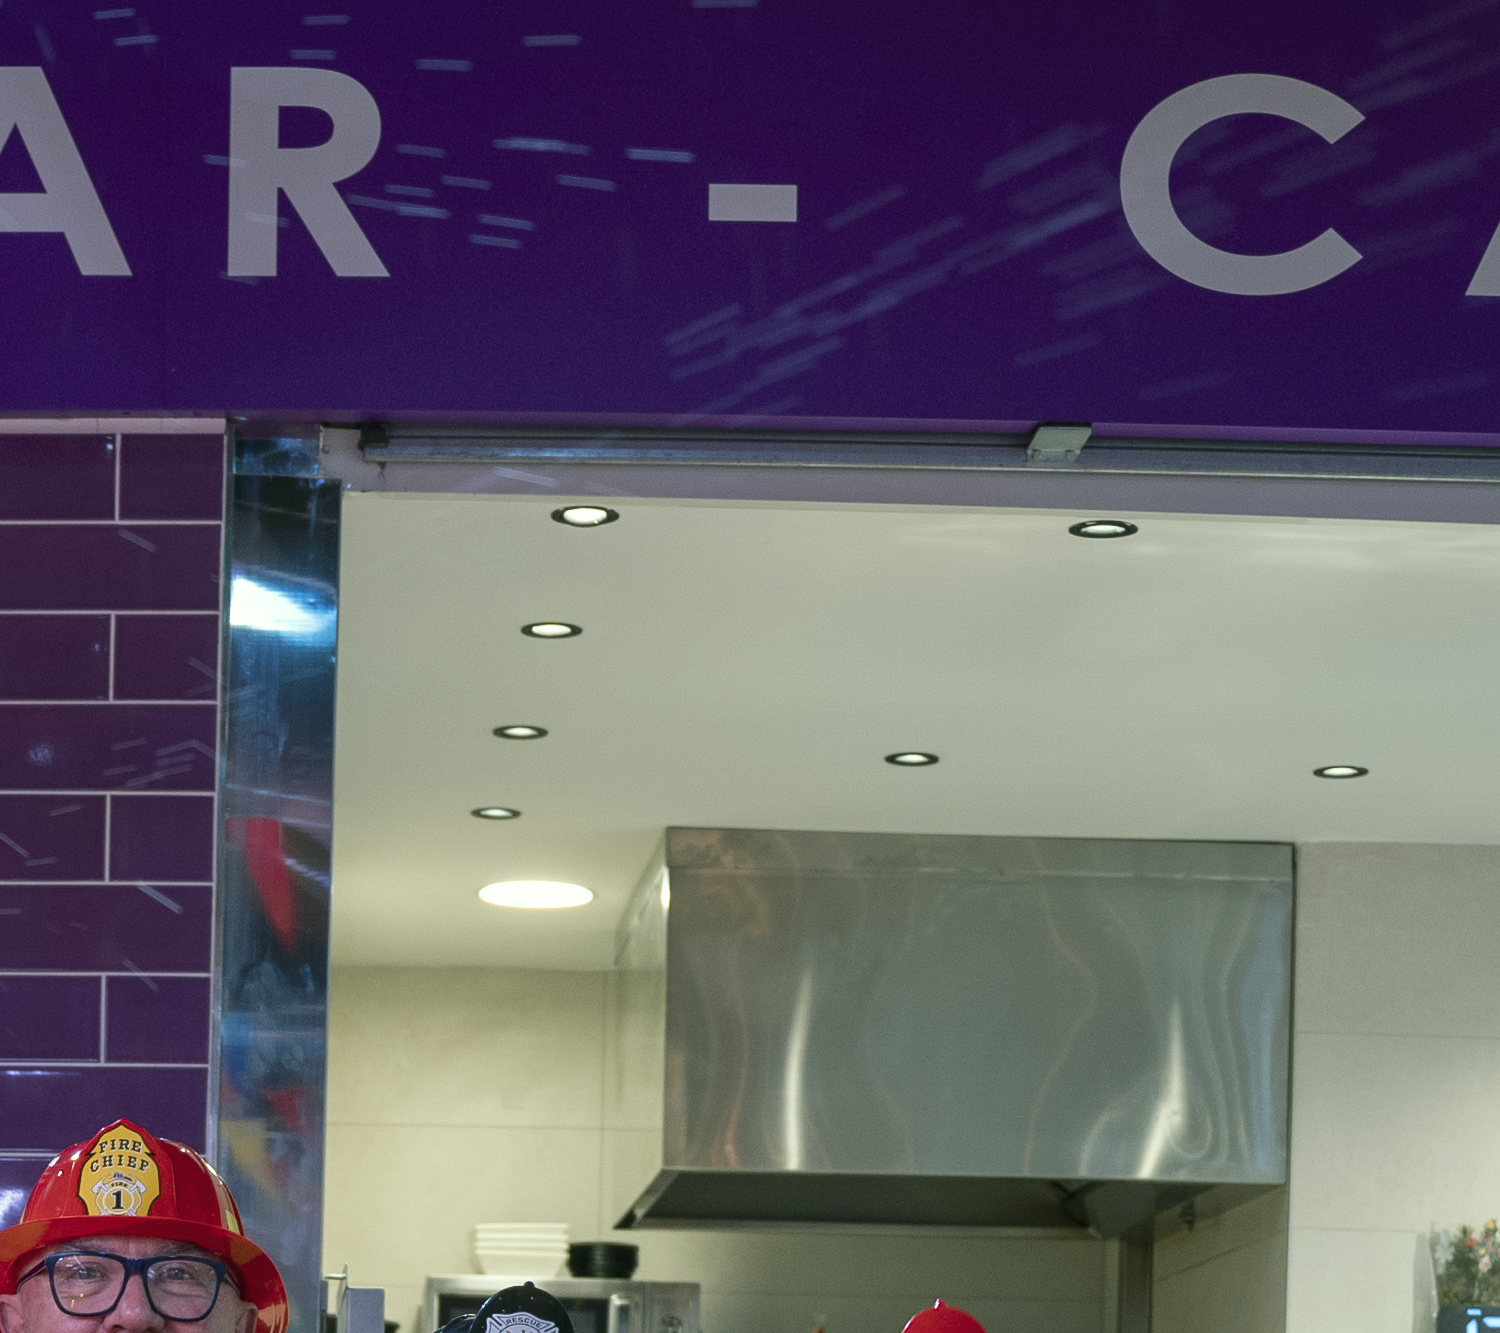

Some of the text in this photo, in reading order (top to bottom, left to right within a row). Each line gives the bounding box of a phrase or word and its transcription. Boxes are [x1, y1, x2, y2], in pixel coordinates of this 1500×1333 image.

[98, 1139, 142, 1155] FIRE
[89, 1154, 150, 1173] CHIEF
[111, 1190, 124, 1209] 1
[505, 1316, 542, 1330] RESCUE
